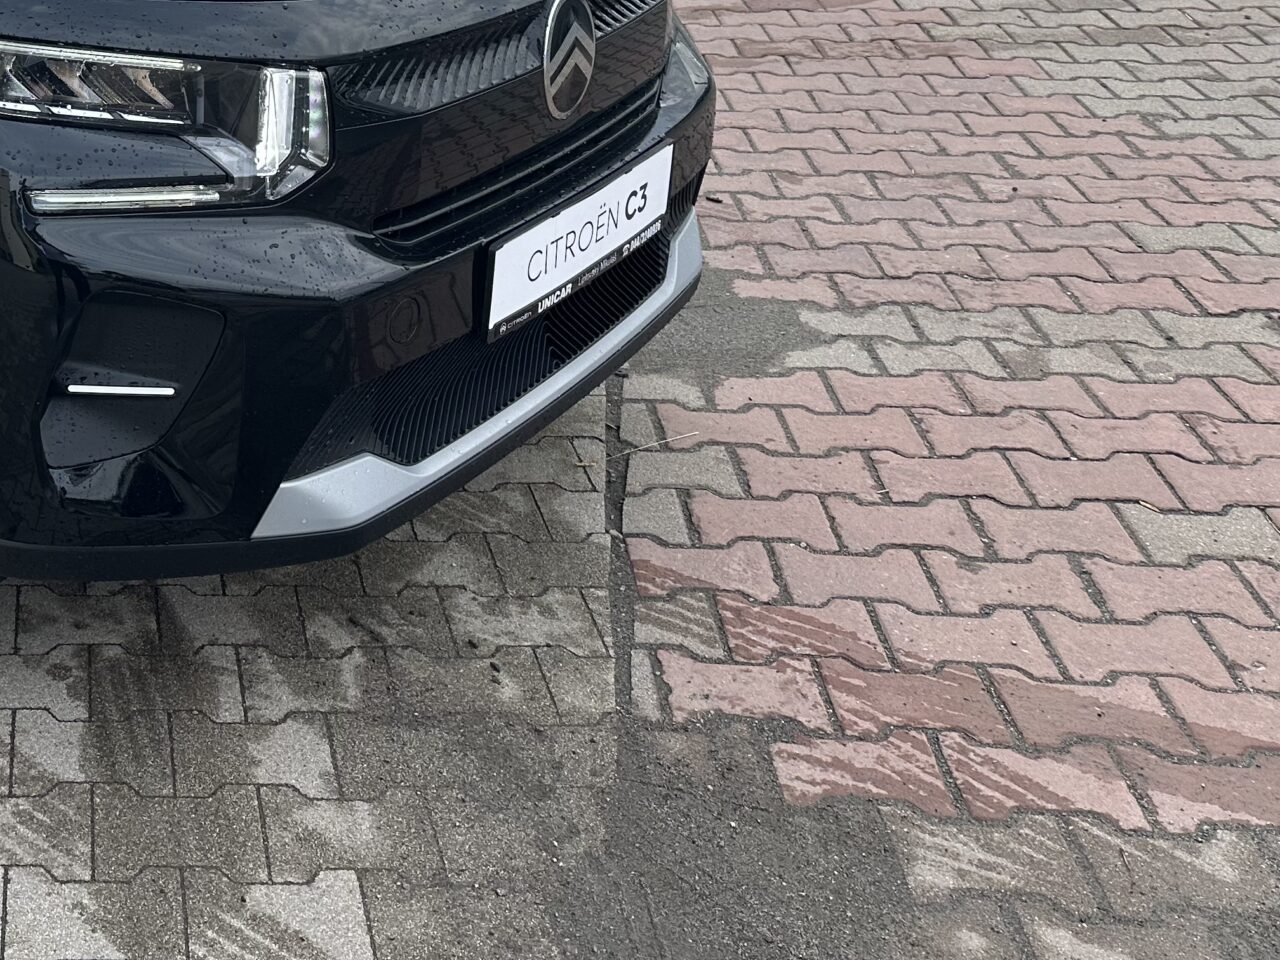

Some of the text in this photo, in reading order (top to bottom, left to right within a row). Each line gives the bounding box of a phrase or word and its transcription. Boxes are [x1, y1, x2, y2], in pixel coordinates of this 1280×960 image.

[527, 182, 648, 282] CITROËN C3
[538, 283, 573, 313] UNICAR
